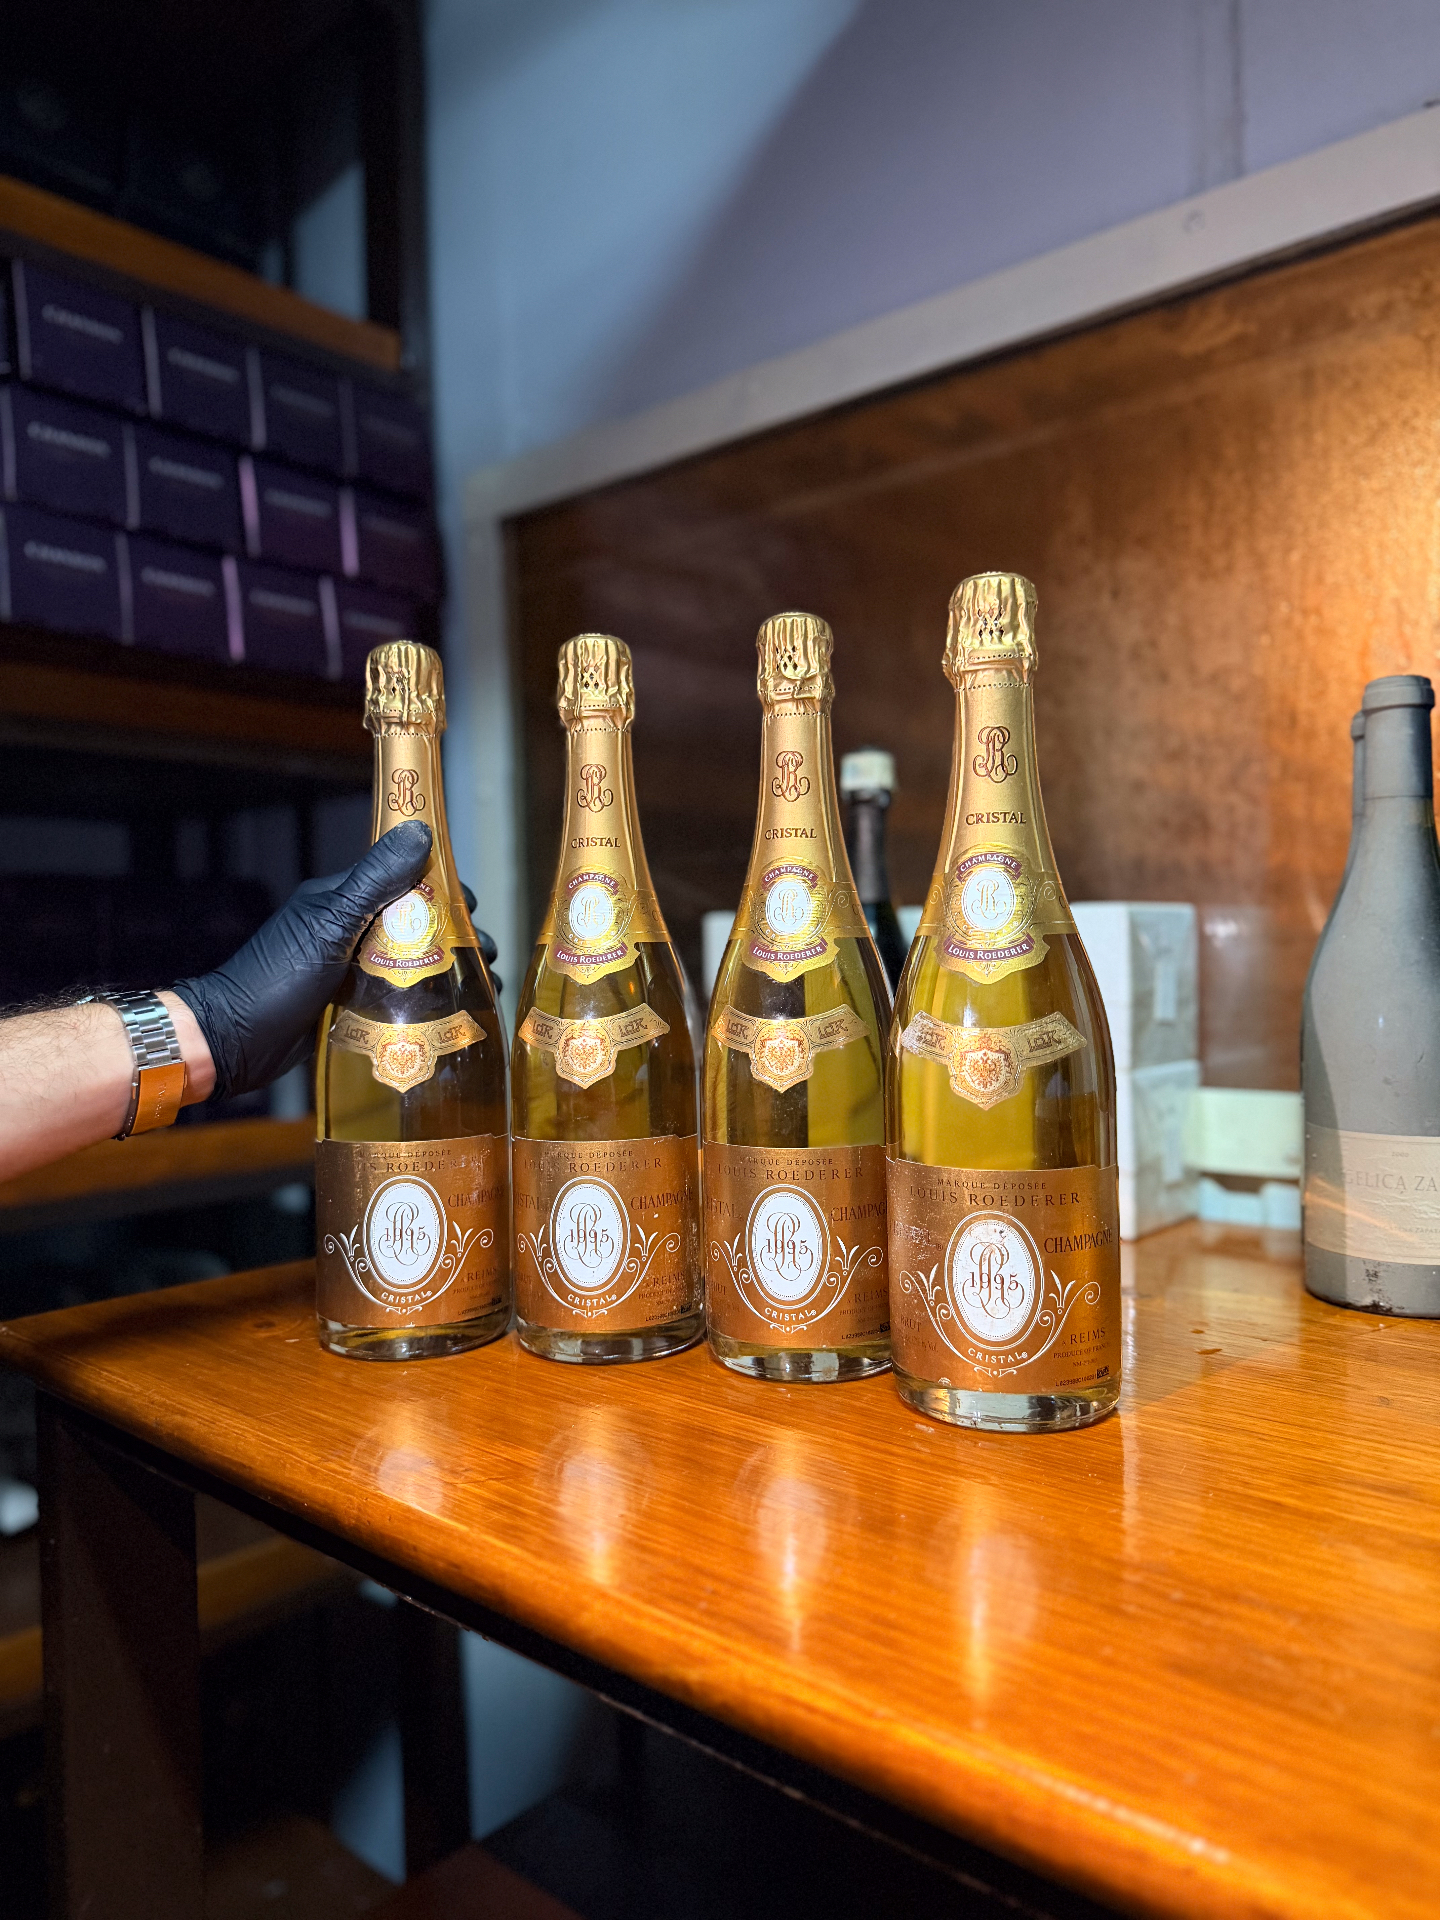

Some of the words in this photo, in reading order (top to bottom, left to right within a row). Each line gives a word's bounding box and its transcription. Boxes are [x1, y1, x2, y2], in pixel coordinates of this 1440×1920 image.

[965, 812, 1026, 825] CRISTAL
[765, 827, 817, 840] CRISTAL
[571, 837, 620, 848] CRISTAL
[960, 854, 1017, 872] CHAMPAGNE
[568, 873, 615, 889] CHAMPAGNE
[765, 866, 814, 882] CHAMPAGNE
[556, 950, 577, 963] LOUIS
[580, 950, 624, 964] ROEDERER
[753, 947, 775, 960] LOUIS
[777, 946, 823, 961] ROEDERER
[948, 944, 974, 959] LOUIS
[977, 943, 1029, 960] ROEDERER
[370, 954, 394, 967] LOUIS
[569, 1157, 661, 1173] ROEDERER
[718, 1163, 757, 1179] LOUIS
[766, 1167, 863, 1181] ROEDERER
[937, 1178, 985, 1190] MARQUE
[910, 1185, 958, 1203] LOUIS
[969, 1192, 1080, 1207] ROEDERER
[831, 1201, 887, 1222] CHAMPAG
[385, 1226, 425, 1241] 1995
[569, 1229, 609, 1244] 1995
[1044, 1229, 1113, 1254] CHAMPAGNE
[766, 1238, 807, 1254] 1995
[969, 1270, 1019, 1290] 1995
[1070, 1327, 1106, 1345] REIMS
